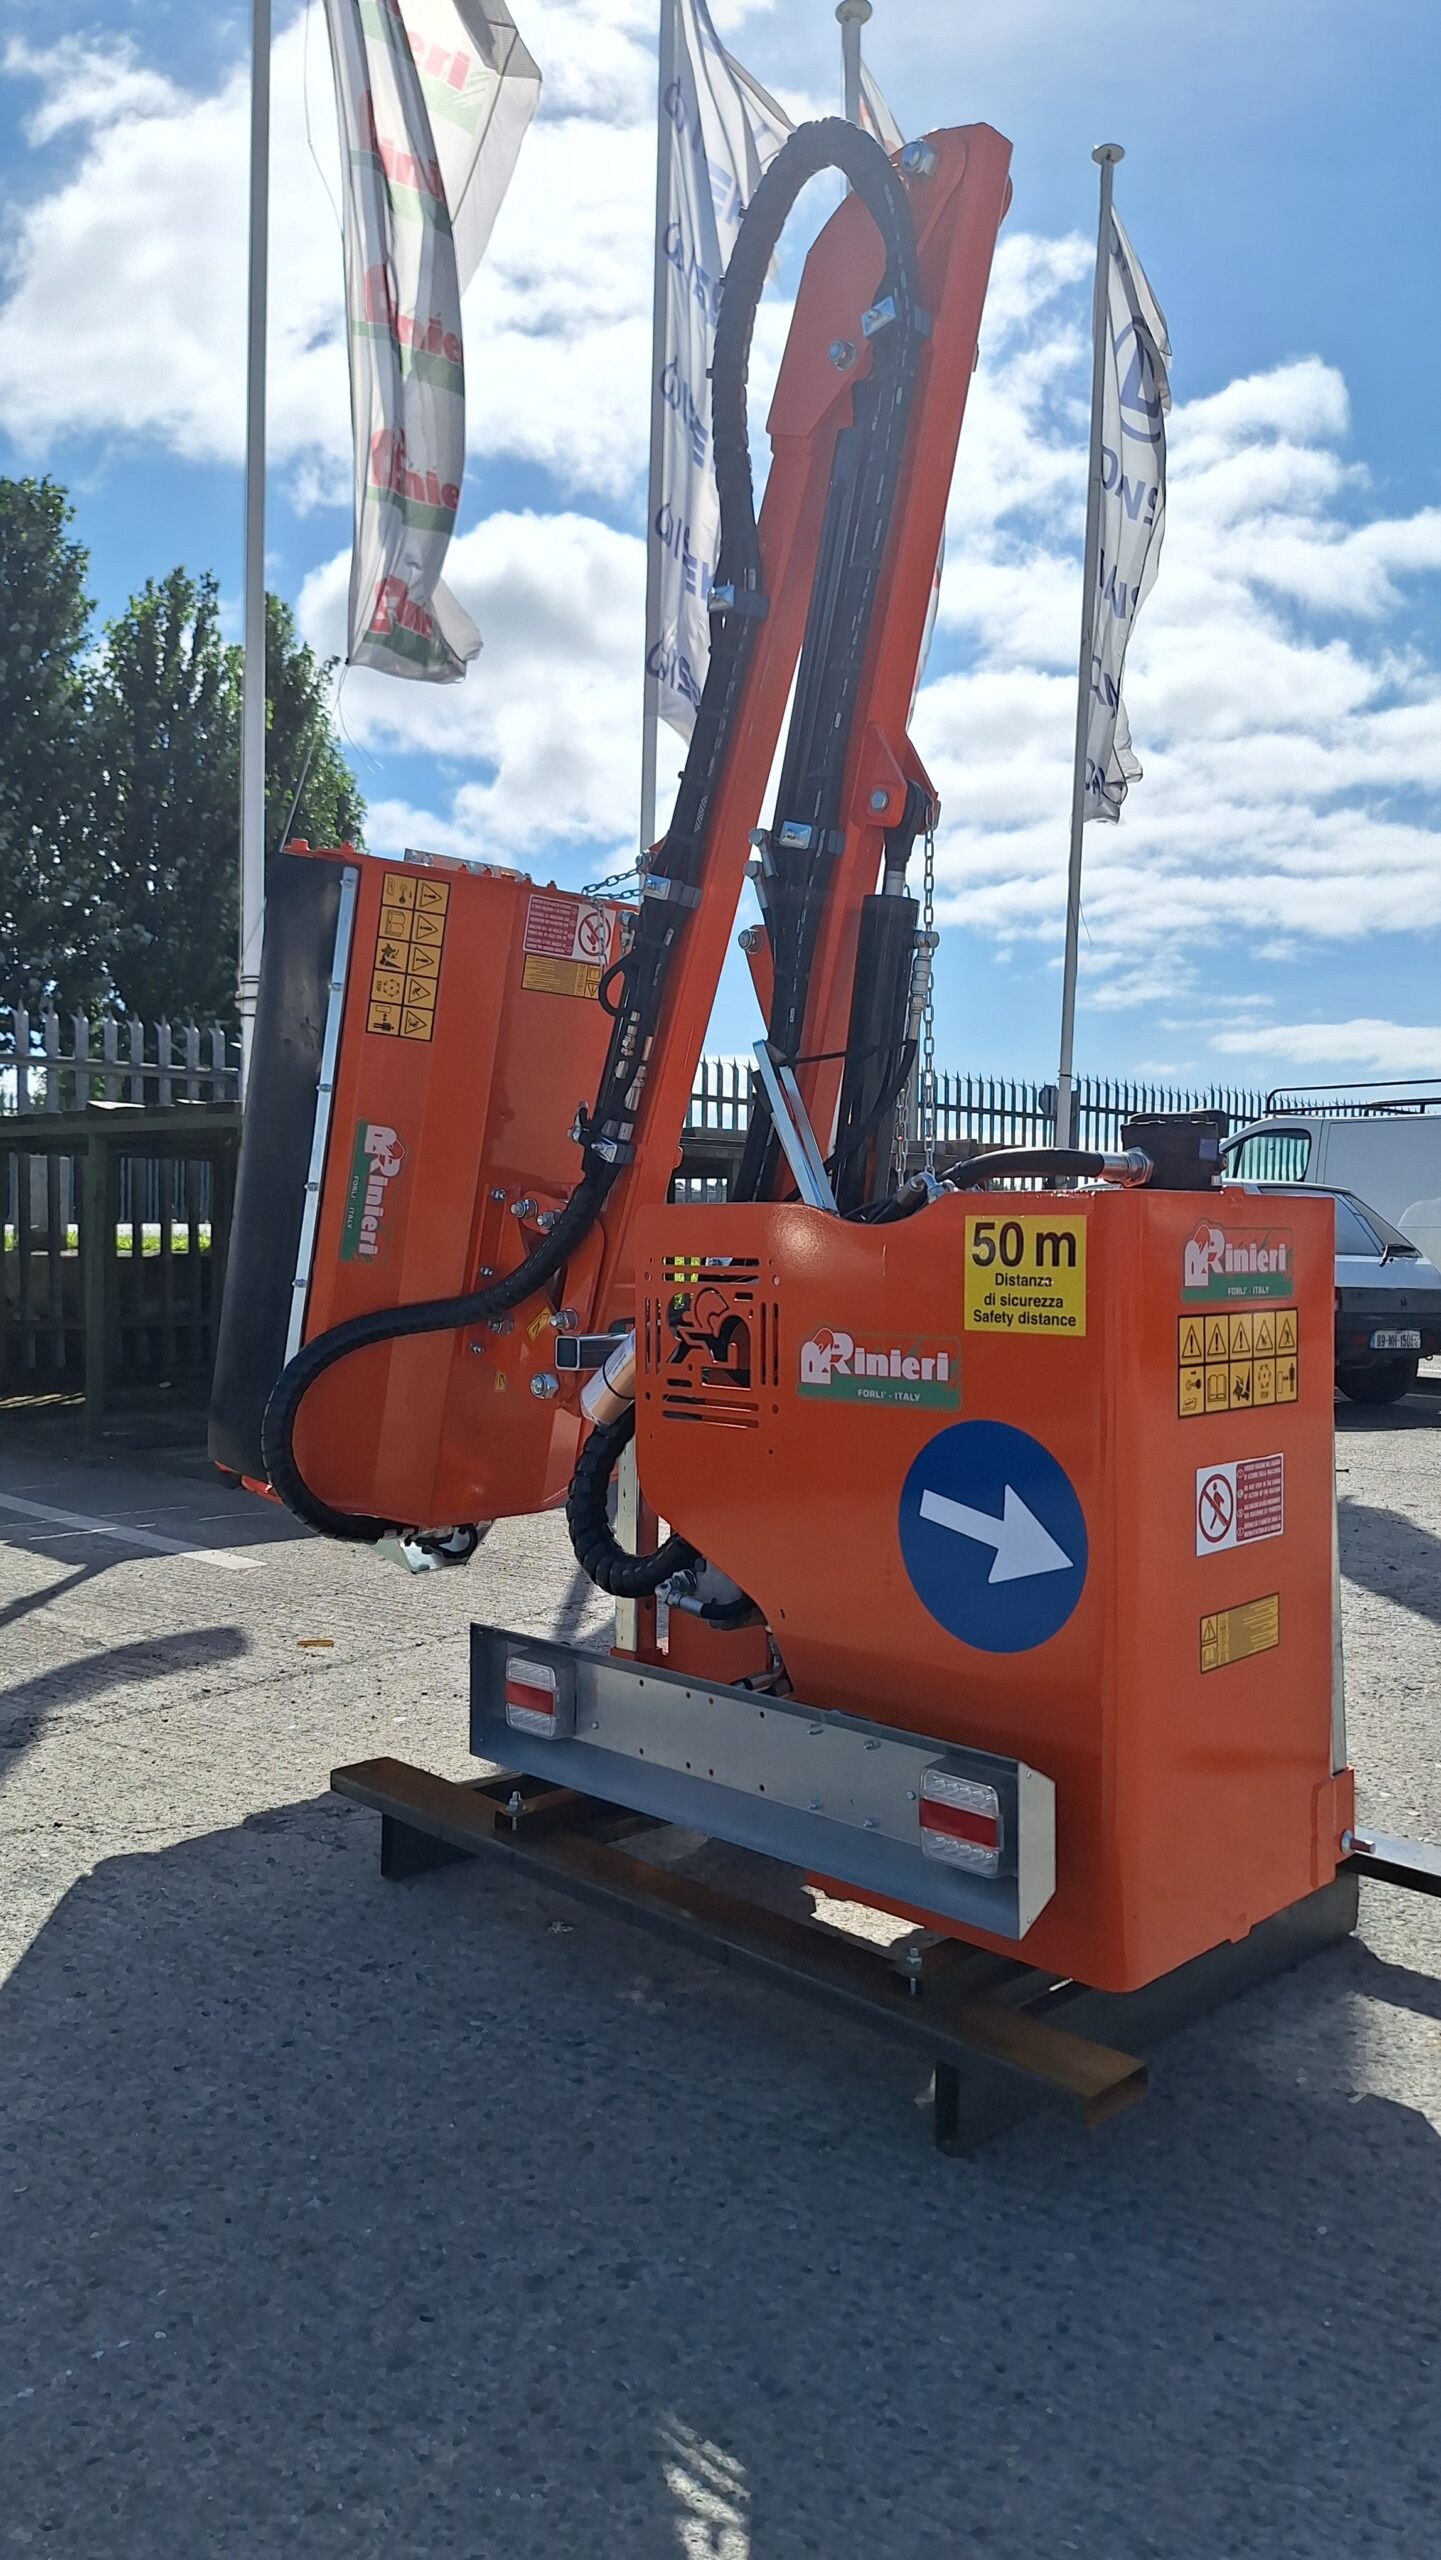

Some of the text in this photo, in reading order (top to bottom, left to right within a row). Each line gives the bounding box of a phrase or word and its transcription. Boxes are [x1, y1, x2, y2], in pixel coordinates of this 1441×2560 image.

[346, 1206, 355, 1230] ITALY
[972, 1221, 1076, 1268] 50 m
[995, 1272, 1053, 1288] Distanza
[1252, 1285, 1270, 1295] ITALY
[984, 1292, 1064, 1308] di sicurezza
[973, 1309, 1077, 1327] Safety distance
[894, 1392, 921, 1402] ITALY
